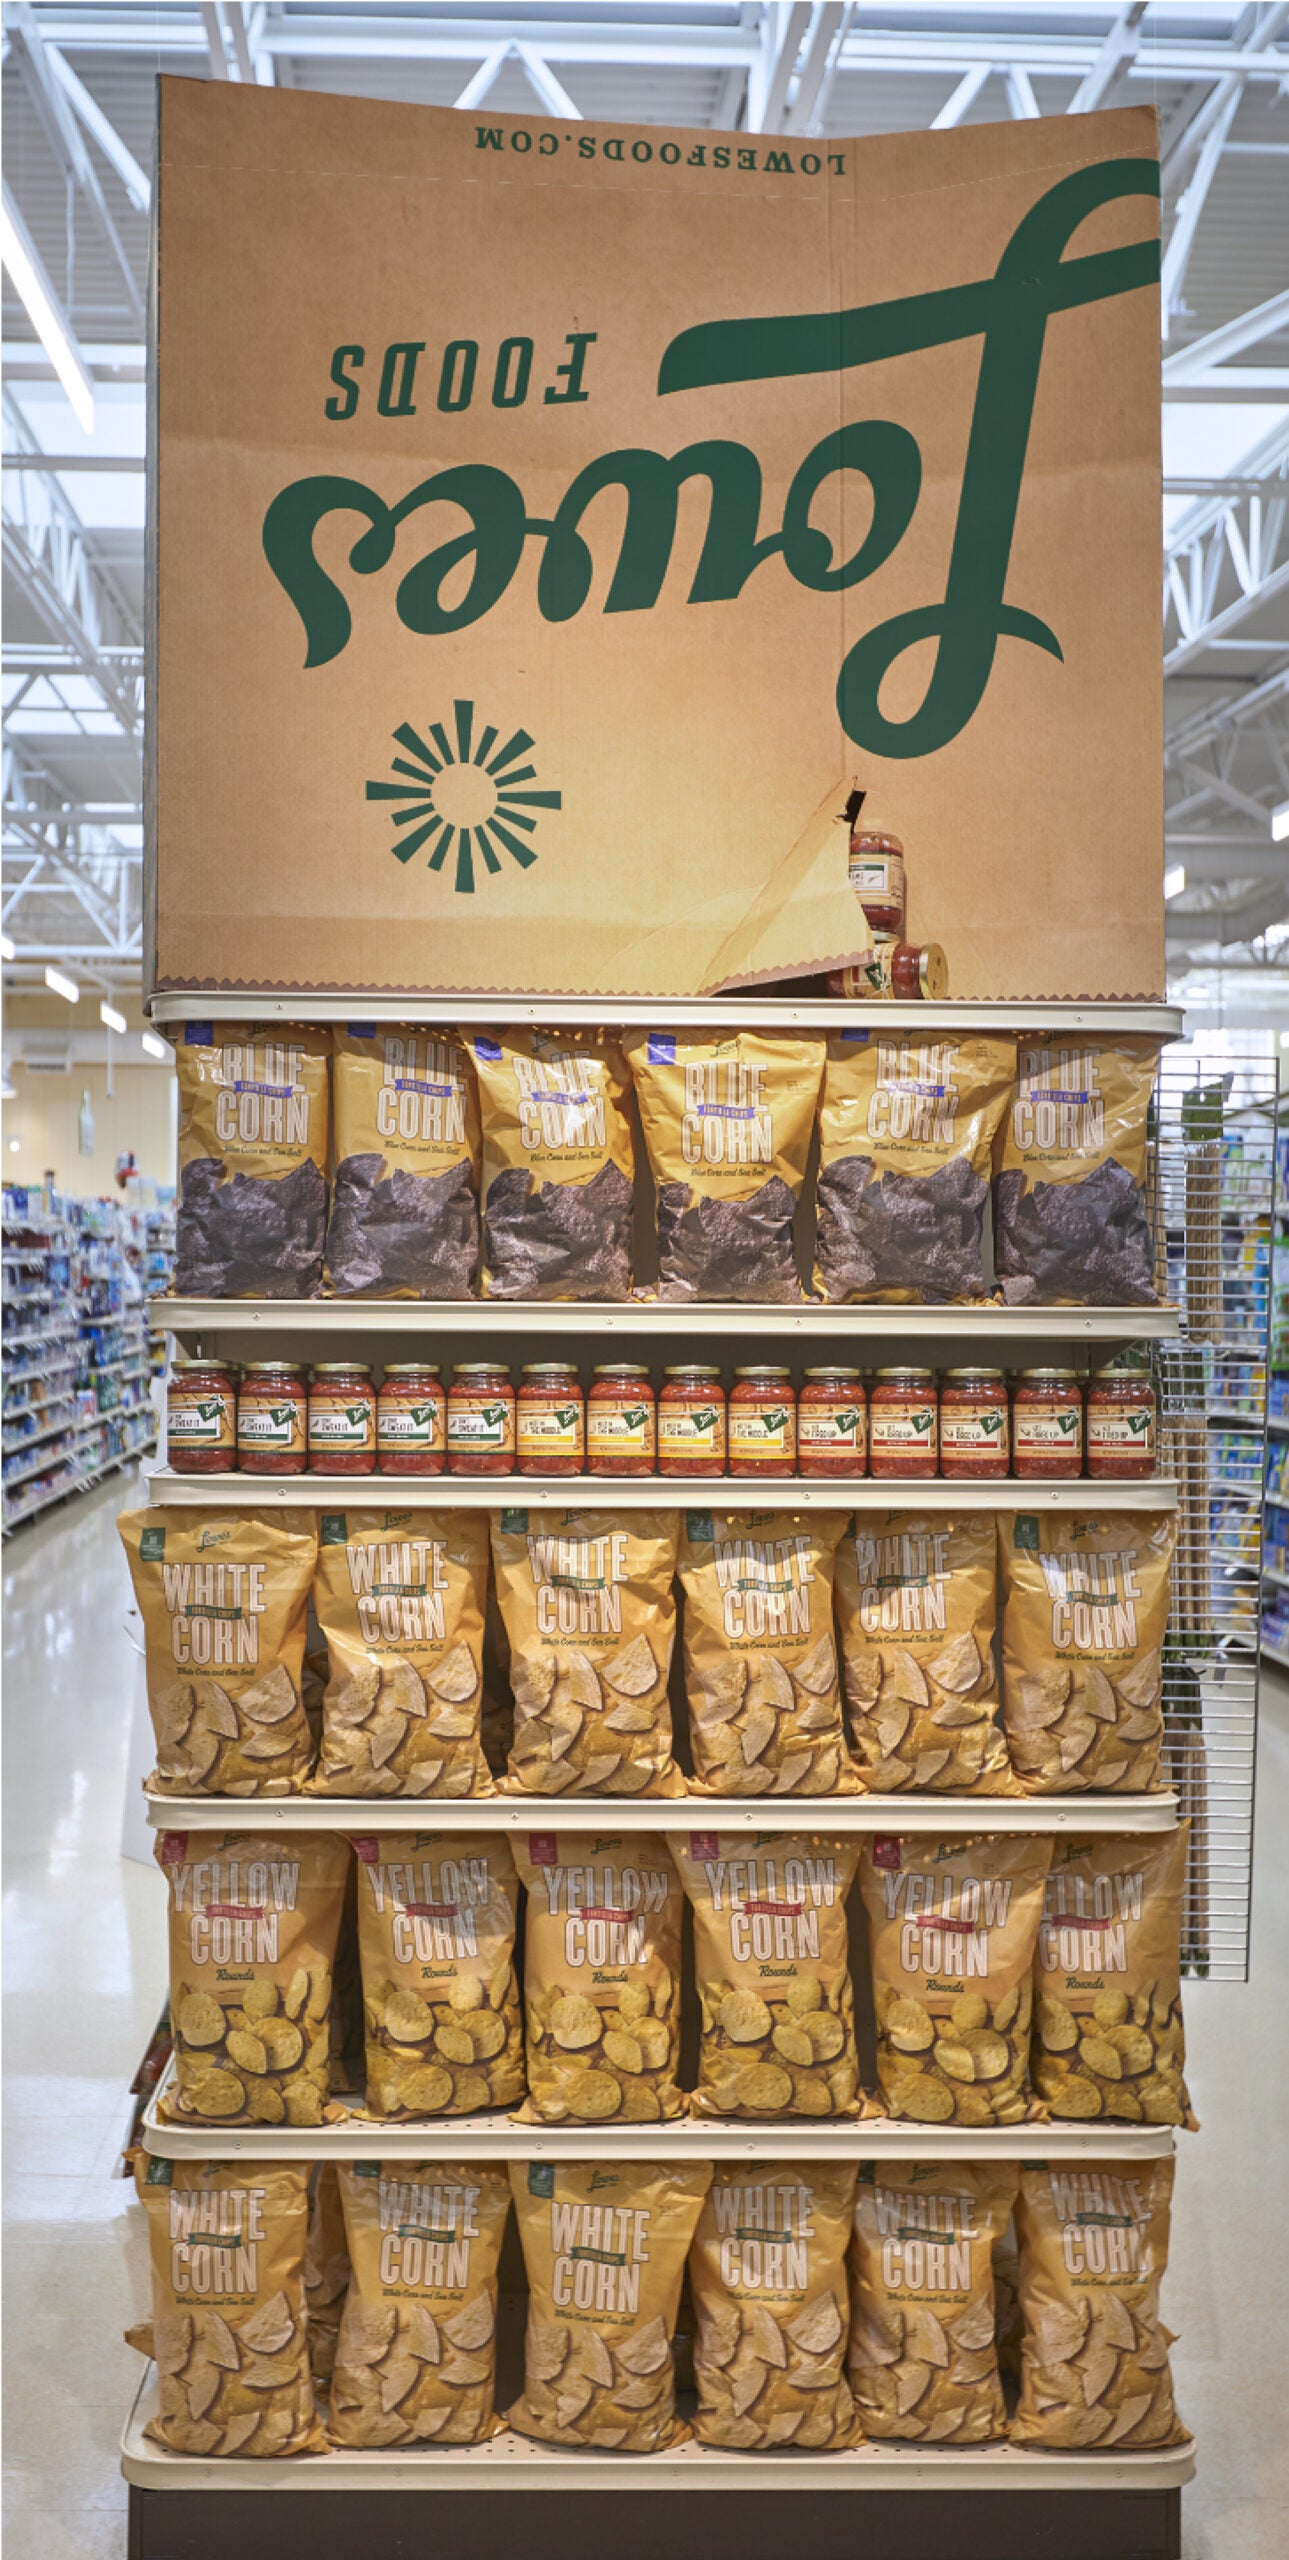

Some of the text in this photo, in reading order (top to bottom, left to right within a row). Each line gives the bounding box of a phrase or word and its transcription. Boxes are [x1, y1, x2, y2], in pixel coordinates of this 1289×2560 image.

[475, 126, 847, 176] LOWESFOODS.COM
[324, 332, 598, 421] FOODS
[263, 158, 1160, 759] Lowes
[222, 1043, 306, 1092] BLUE
[384, 1037, 464, 1091] BLUE
[685, 1062, 768, 1112] BLUE
[1019, 1049, 1100, 1097] BLUE
[216, 1091, 309, 1144] CORN
[377, 1088, 467, 1144] CORN
[519, 1096, 606, 1149] CORN
[681, 1114, 772, 1164] CORN
[868, 1091, 960, 1143] CORN
[1014, 1100, 1104, 1149] CORN
[346, 1541, 449, 1594] WHITE
[527, 1535, 629, 1584] WHITE
[713, 1536, 815, 1587] WHITE
[855, 1533, 952, 1585] WHITE
[1038, 1551, 1141, 1598] WHITE
[162, 1563, 266, 1612] WHITE
[537, 1584, 622, 1634] CORN
[723, 1586, 810, 1638] CORN
[860, 1583, 946, 1632] CORN
[172, 1615, 259, 1664] CORN
[358, 1591, 446, 1644] CORN
[1052, 1600, 1137, 1649] CORN
[169, 1862, 300, 1912] YELLOW
[366, 1858, 488, 1914] YELLOW
[542, 1865, 668, 1916] YELLOW
[704, 1858, 835, 1911] YELLOW
[884, 1871, 1012, 1928] YELLOW
[1040, 1873, 1143, 1921] ELLOW
[191, 1913, 279, 1964] CORN
[393, 1908, 479, 1963] CORN
[566, 1915, 648, 1967] CORN
[731, 1910, 820, 1962] CORN
[902, 1922, 988, 1977] CORN
[1039, 1923, 1128, 1972] CORN
[759, 1965, 798, 1977] Rounds
[1066, 1976, 1105, 1989] Rounds
[169, 2188, 266, 2240] WHITE
[378, 2181, 481, 2237] WHITE
[712, 2186, 815, 2237] WHITE
[874, 2188, 979, 2238] WHITE
[1050, 2173, 1152, 2222] WHITE
[552, 2202, 650, 2262] WHITE
[172, 2241, 258, 2293] CORN
[380, 2234, 469, 2288] CORN
[553, 2256, 640, 2313] CORN
[720, 2237, 808, 2290] CORN
[883, 2238, 971, 2291] CORN
